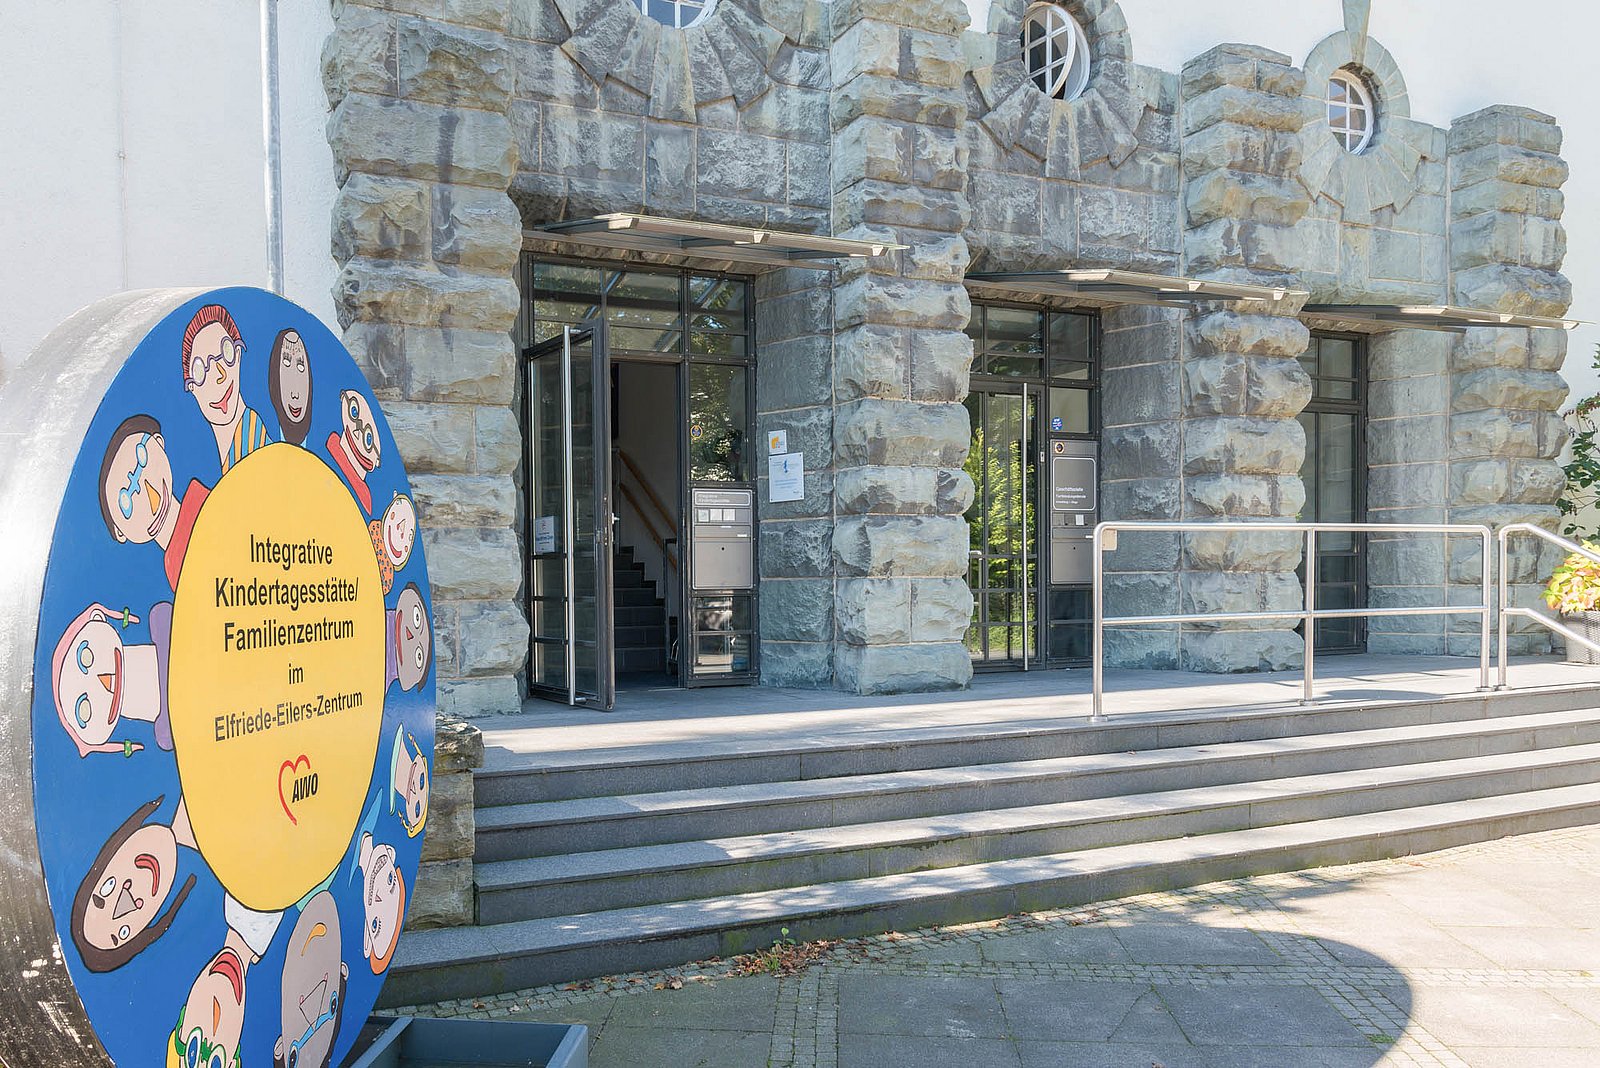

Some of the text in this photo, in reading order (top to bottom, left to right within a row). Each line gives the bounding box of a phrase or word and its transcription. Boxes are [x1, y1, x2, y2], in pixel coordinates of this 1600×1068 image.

[250, 534, 333, 571] Integrative
[215, 577, 359, 611] Kindertagesstätte/
[224, 619, 355, 652] Familienzentrum
[288, 663, 304, 685] im
[214, 690, 363, 742] Elfriede-Eilers-Zentrum
[291, 773, 318, 803] AWO
